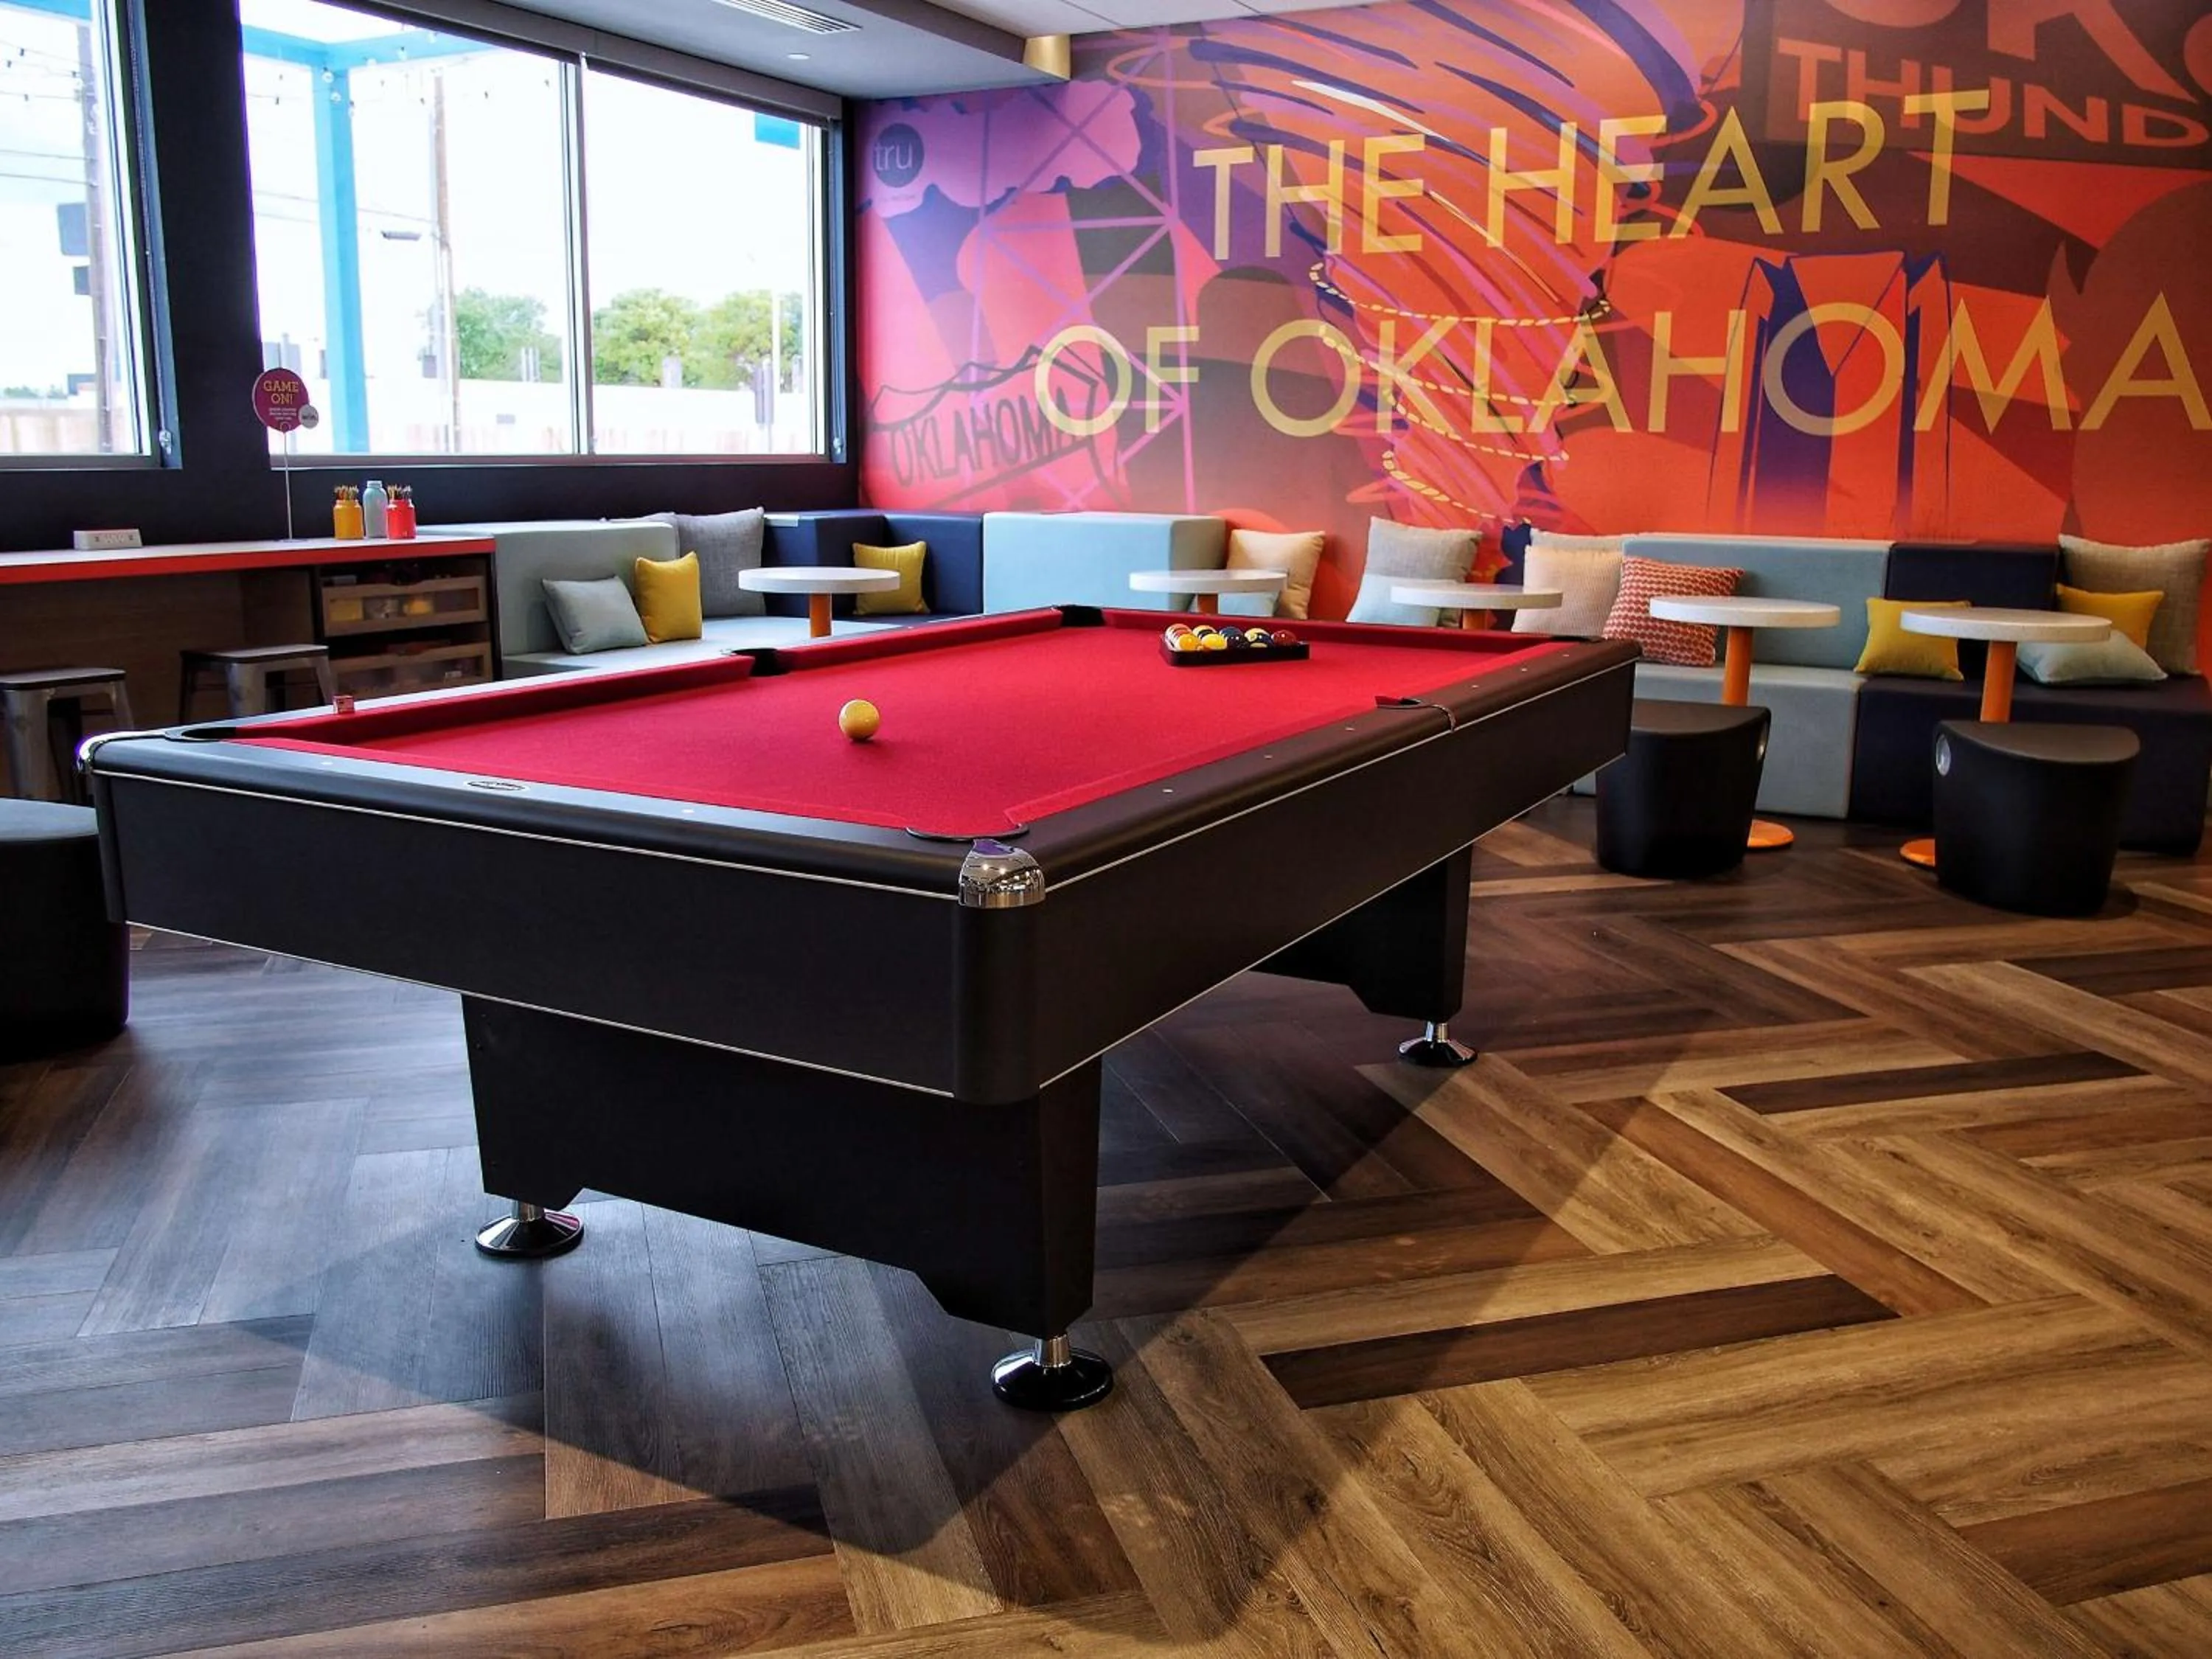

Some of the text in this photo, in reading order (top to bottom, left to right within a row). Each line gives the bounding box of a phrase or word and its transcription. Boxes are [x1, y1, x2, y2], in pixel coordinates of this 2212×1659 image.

[874, 142, 913, 171] tru
[1193, 89, 1989, 260] THE HEART
[263, 380, 299, 392] GAME
[1034, 291, 2212, 438] OF OKLAHOMA
[271, 393, 294, 405] ON!
[891, 386, 1084, 487] OKLAHOMA
